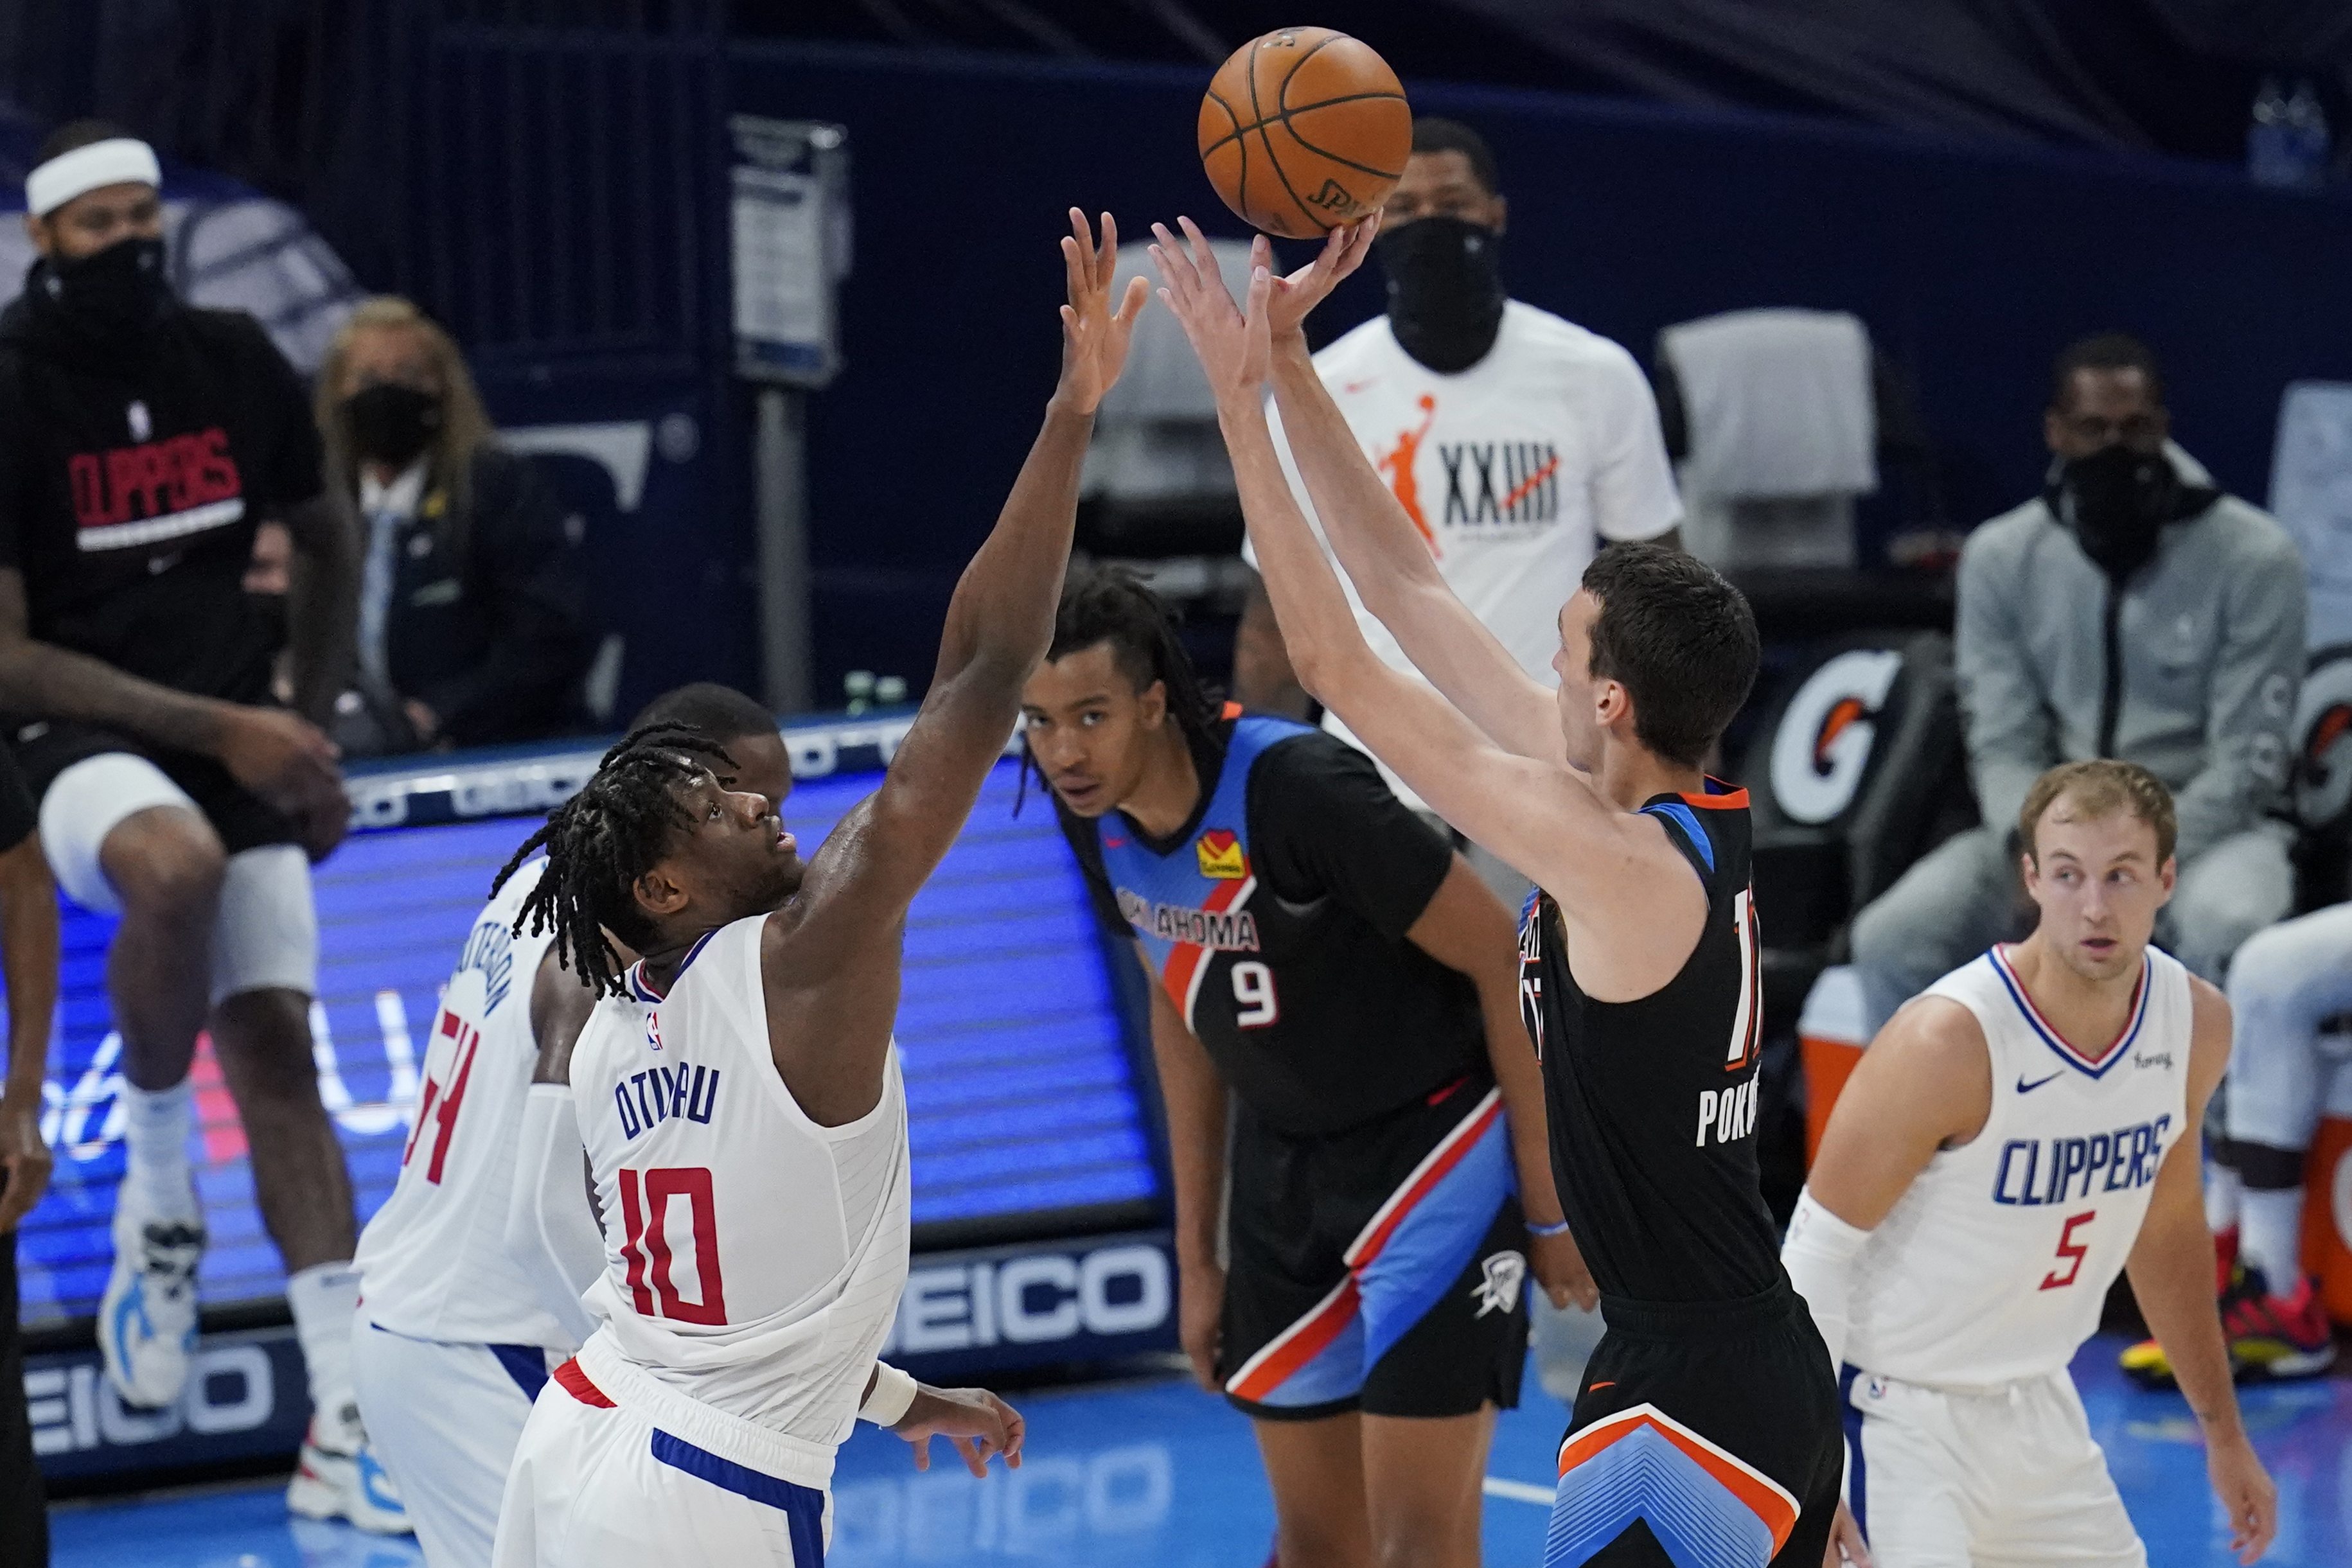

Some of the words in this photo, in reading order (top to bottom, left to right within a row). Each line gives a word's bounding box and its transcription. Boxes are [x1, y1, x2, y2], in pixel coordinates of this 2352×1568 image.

[1232, 961, 1280, 1030] 9
[1992, 1113, 2171, 1206] CLIPPERS
[619, 1167, 728, 1325] 10
[2038, 1210, 2096, 1291] 5
[875, 1245, 1171, 1355] EICO
